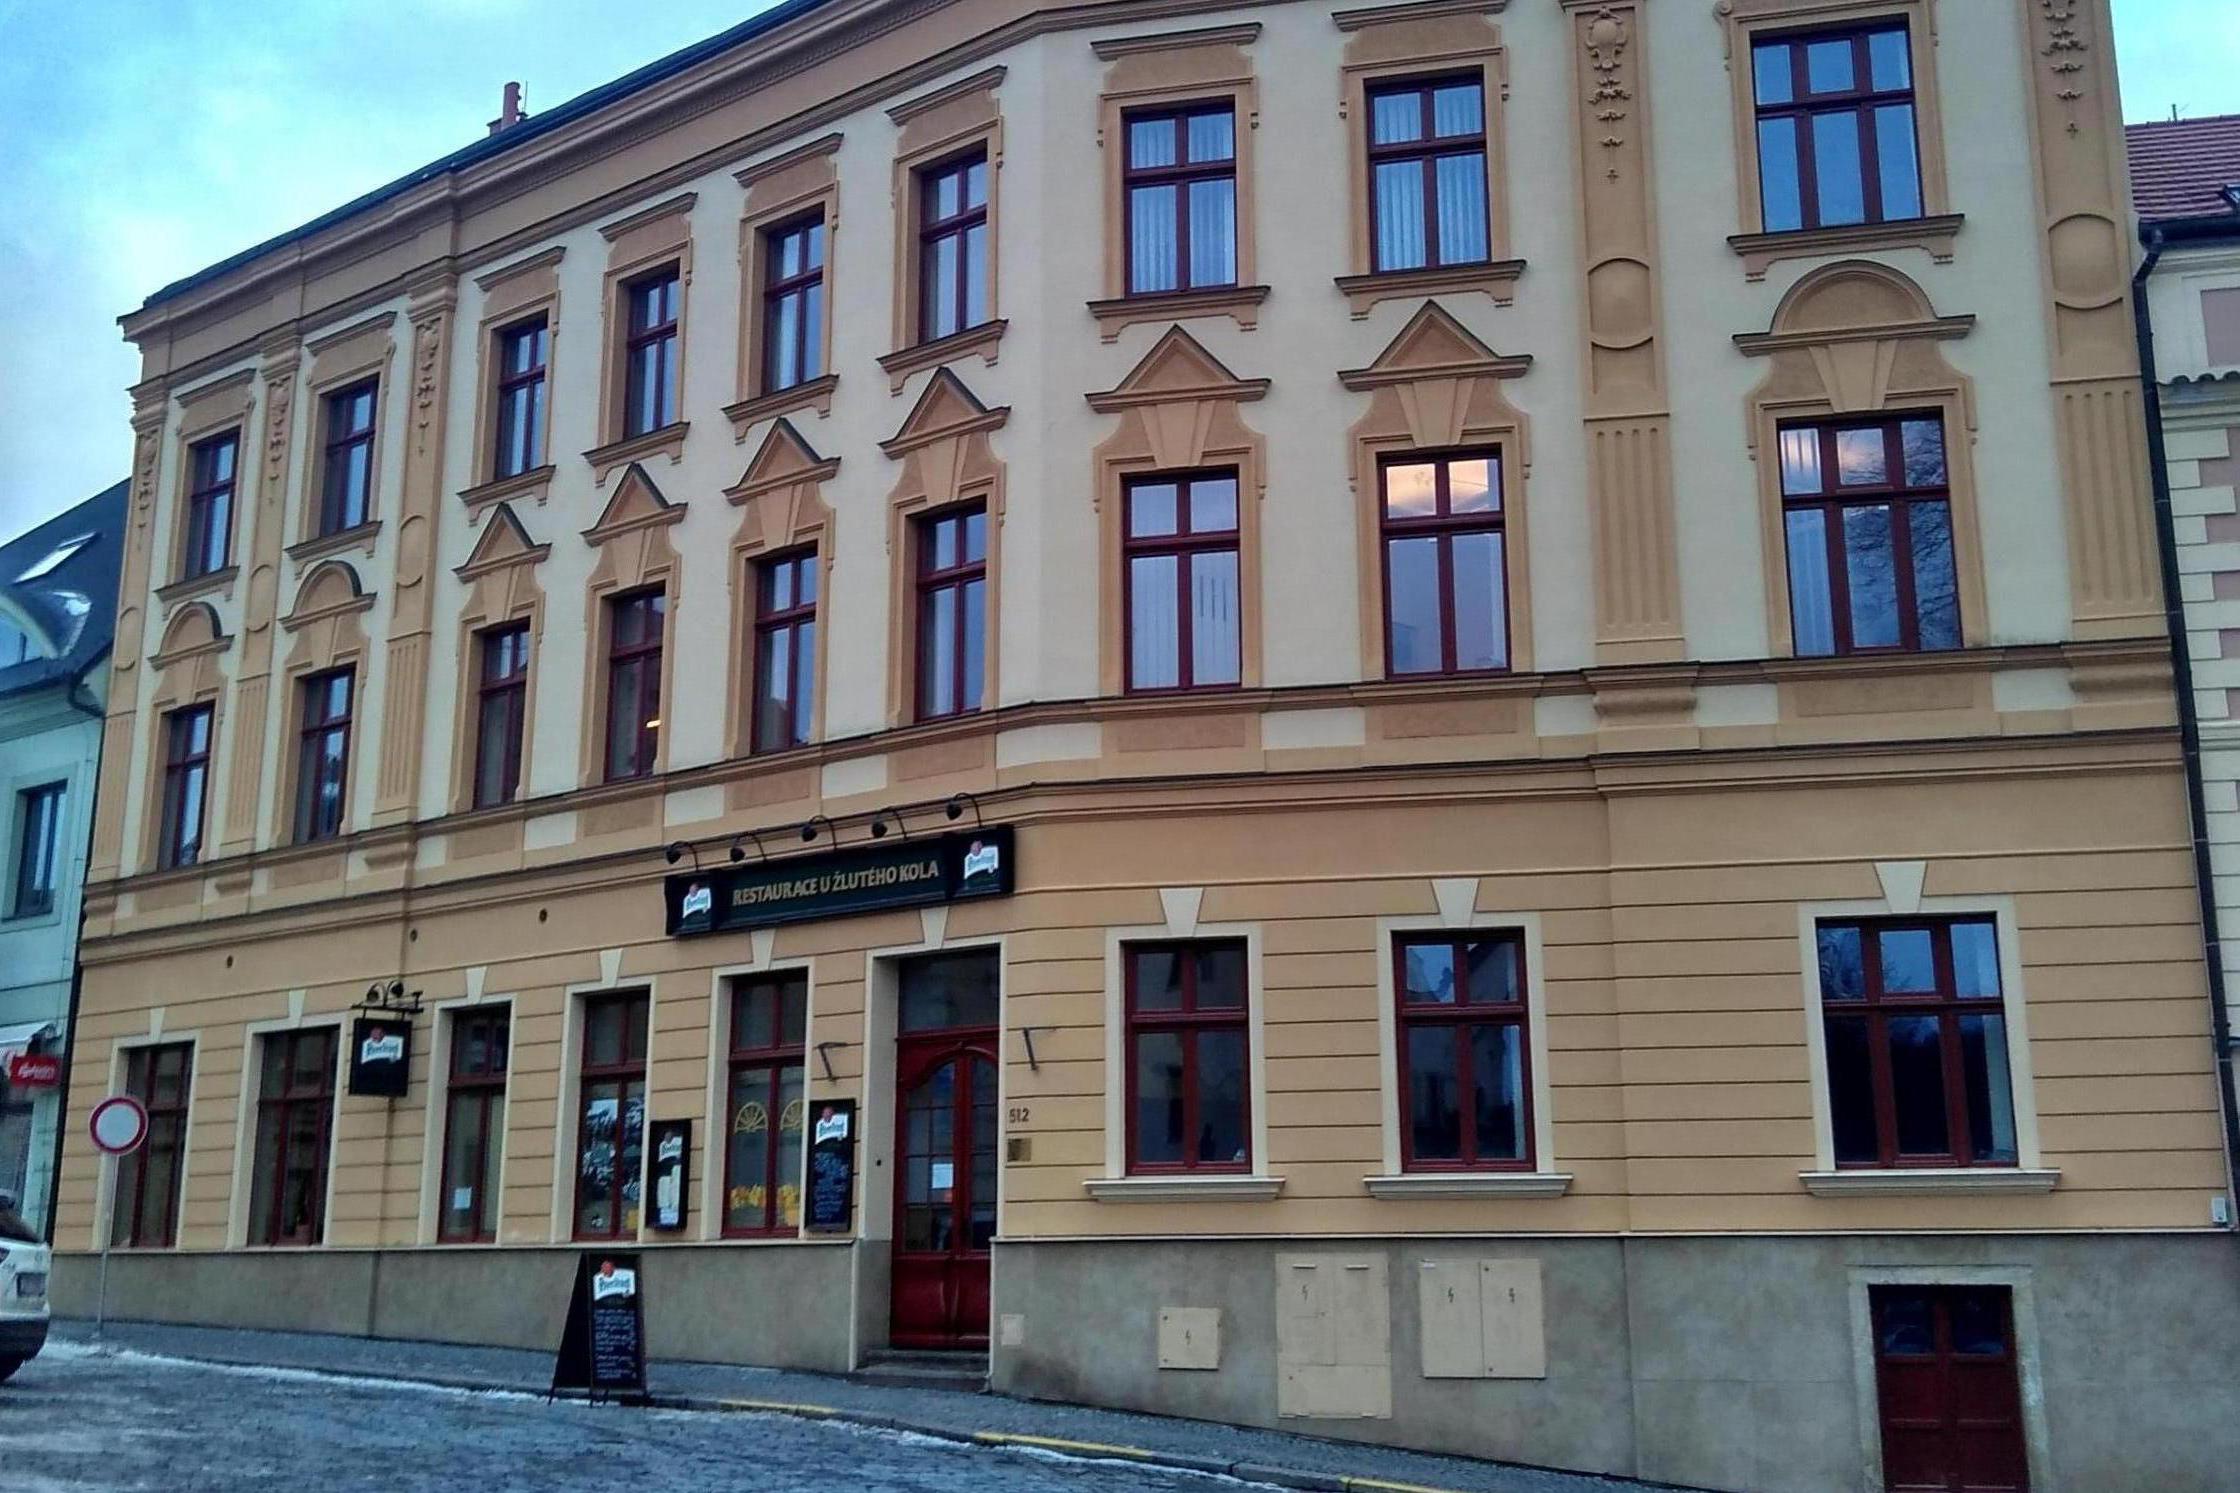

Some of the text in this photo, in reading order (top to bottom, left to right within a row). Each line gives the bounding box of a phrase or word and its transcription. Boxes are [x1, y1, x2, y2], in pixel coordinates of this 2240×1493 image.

[733, 878, 818, 906] RESTAURACE
[820, 875, 831, 892] U
[899, 860, 939, 882] KOLA
